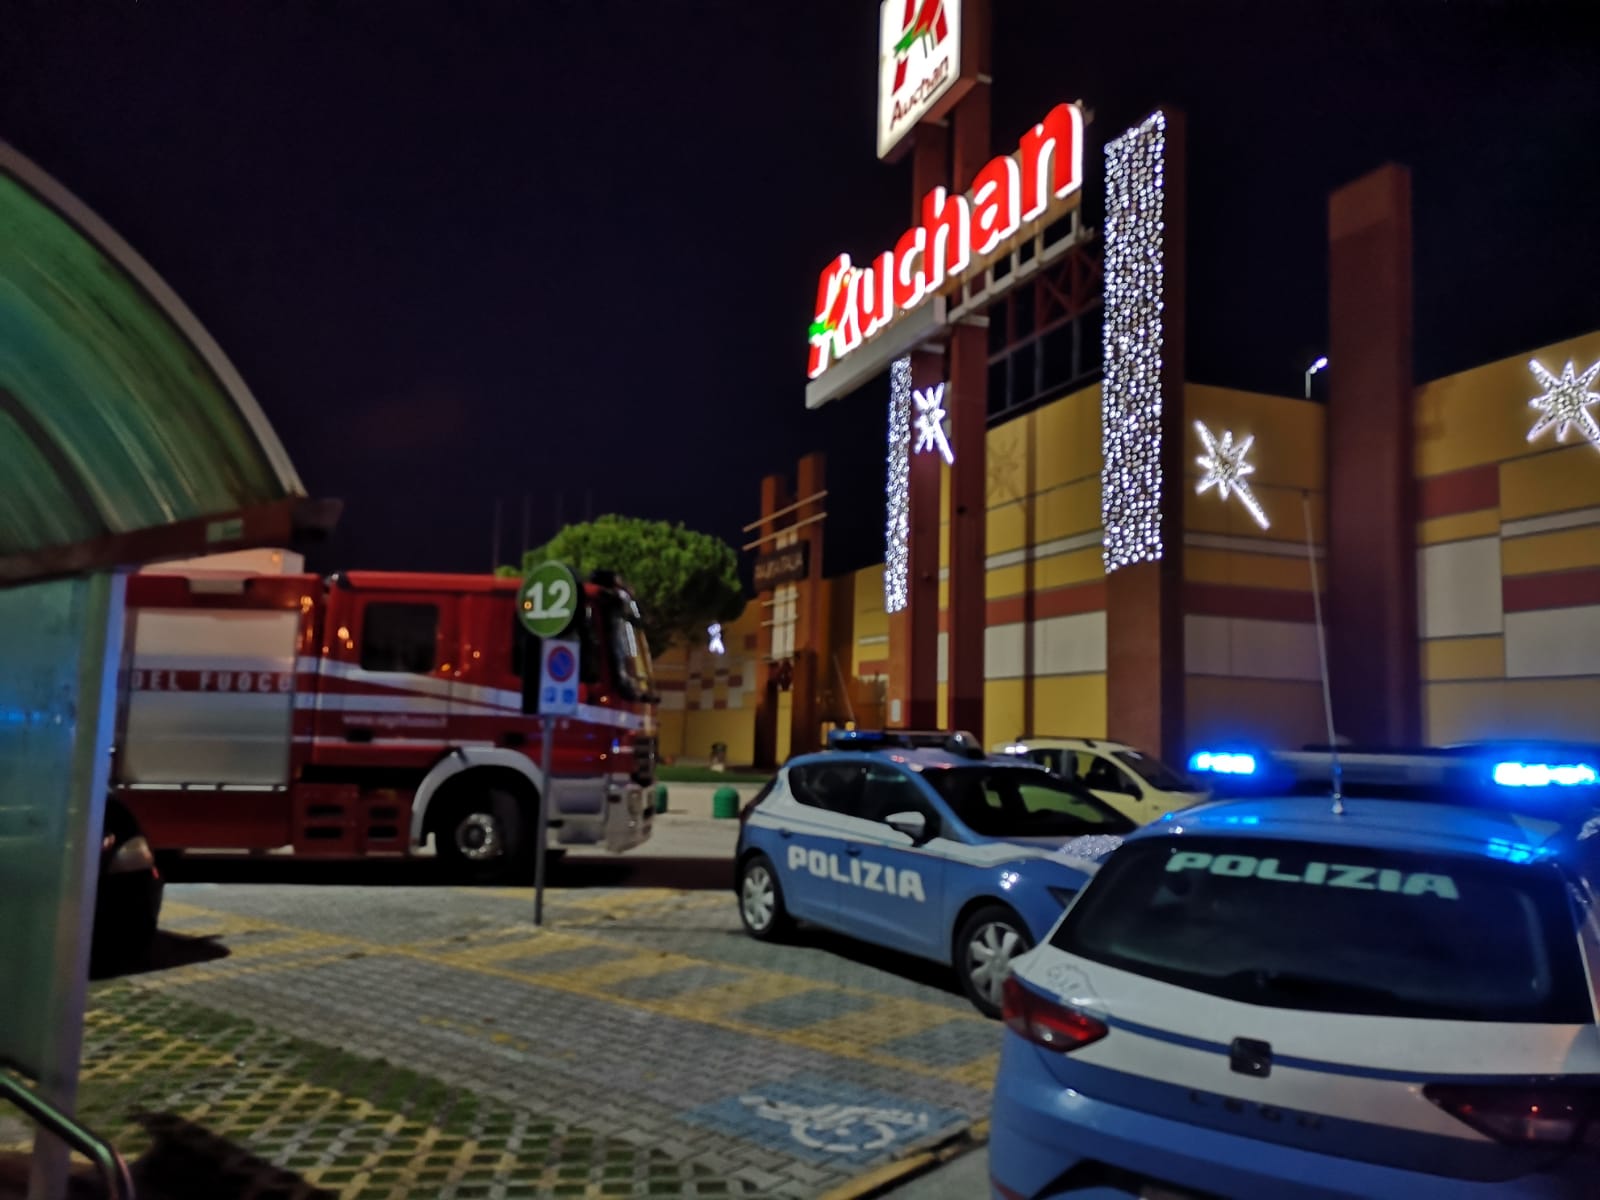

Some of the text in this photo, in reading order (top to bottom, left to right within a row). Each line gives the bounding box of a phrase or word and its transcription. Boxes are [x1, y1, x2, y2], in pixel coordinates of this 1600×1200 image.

[889, 55, 949, 130] Auchan
[807, 102, 1083, 378] Auchan
[526, 579, 572, 620] 12
[788, 844, 926, 903] POLIZIA
[1165, 851, 1459, 900] POLIZIA
